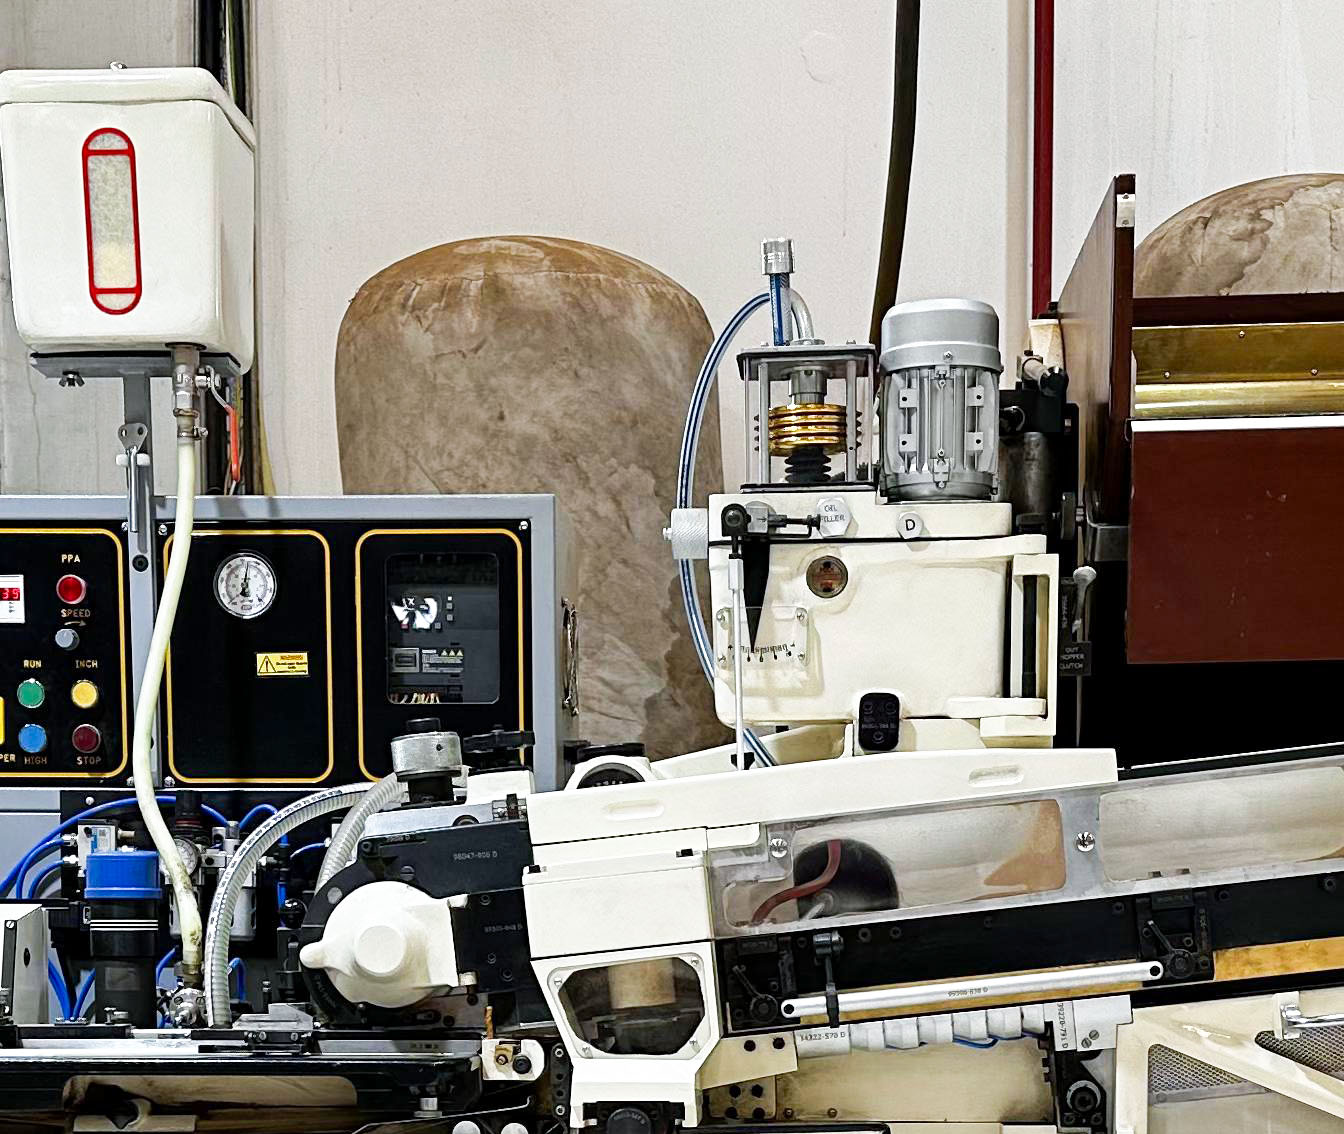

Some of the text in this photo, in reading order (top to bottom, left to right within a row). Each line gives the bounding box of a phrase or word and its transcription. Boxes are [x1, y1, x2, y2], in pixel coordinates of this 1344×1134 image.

[905, 519, 915, 531] D
[61, 554, 81, 563] PPA
[61, 609, 91, 618] SPEED
[23, 660, 42, 668] RUN
[75, 660, 98, 668] INCH
[24, 756, 47, 765] HIGH
[76, 756, 101, 765] STOP
